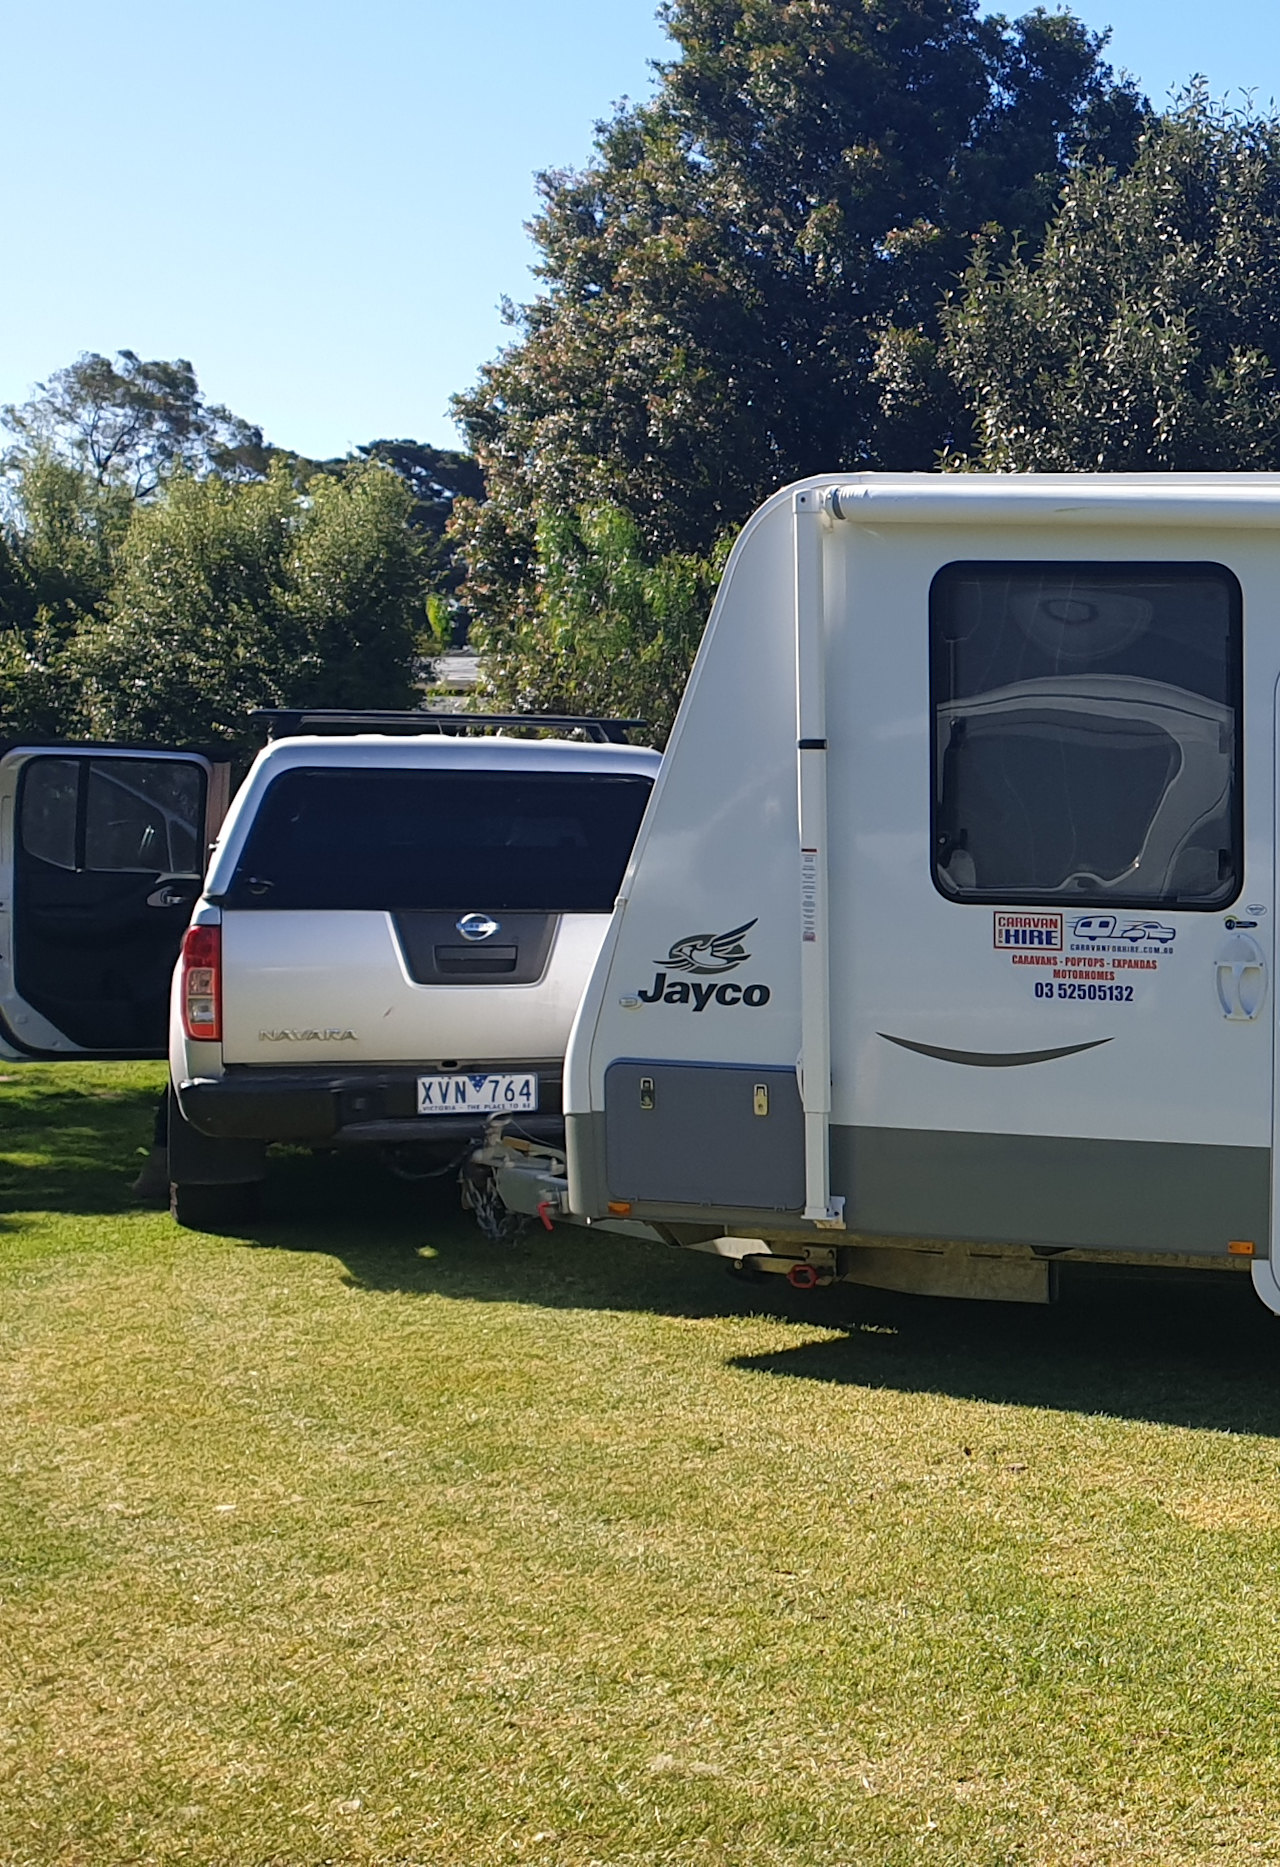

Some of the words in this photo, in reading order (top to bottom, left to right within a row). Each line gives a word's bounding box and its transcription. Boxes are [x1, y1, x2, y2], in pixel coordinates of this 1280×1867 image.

[998, 917, 1058, 928] CARAVAN
[1005, 929, 1058, 945] HIRE
[1012, 955, 1058, 966] CARAVANS
[1065, 957, 1105, 968] POPTOPS
[1112, 959, 1157, 969] EXPANDAS
[1053, 969, 1115, 981] MOTORHOMES
[637, 973, 770, 1012] Jayco
[1035, 982, 1054, 999] 03
[1058, 983, 1134, 1002] 52505132
[259, 1029, 359, 1041] NAVARA
[421, 1081, 467, 1105] XVN
[488, 1079, 531, 1103] 764
